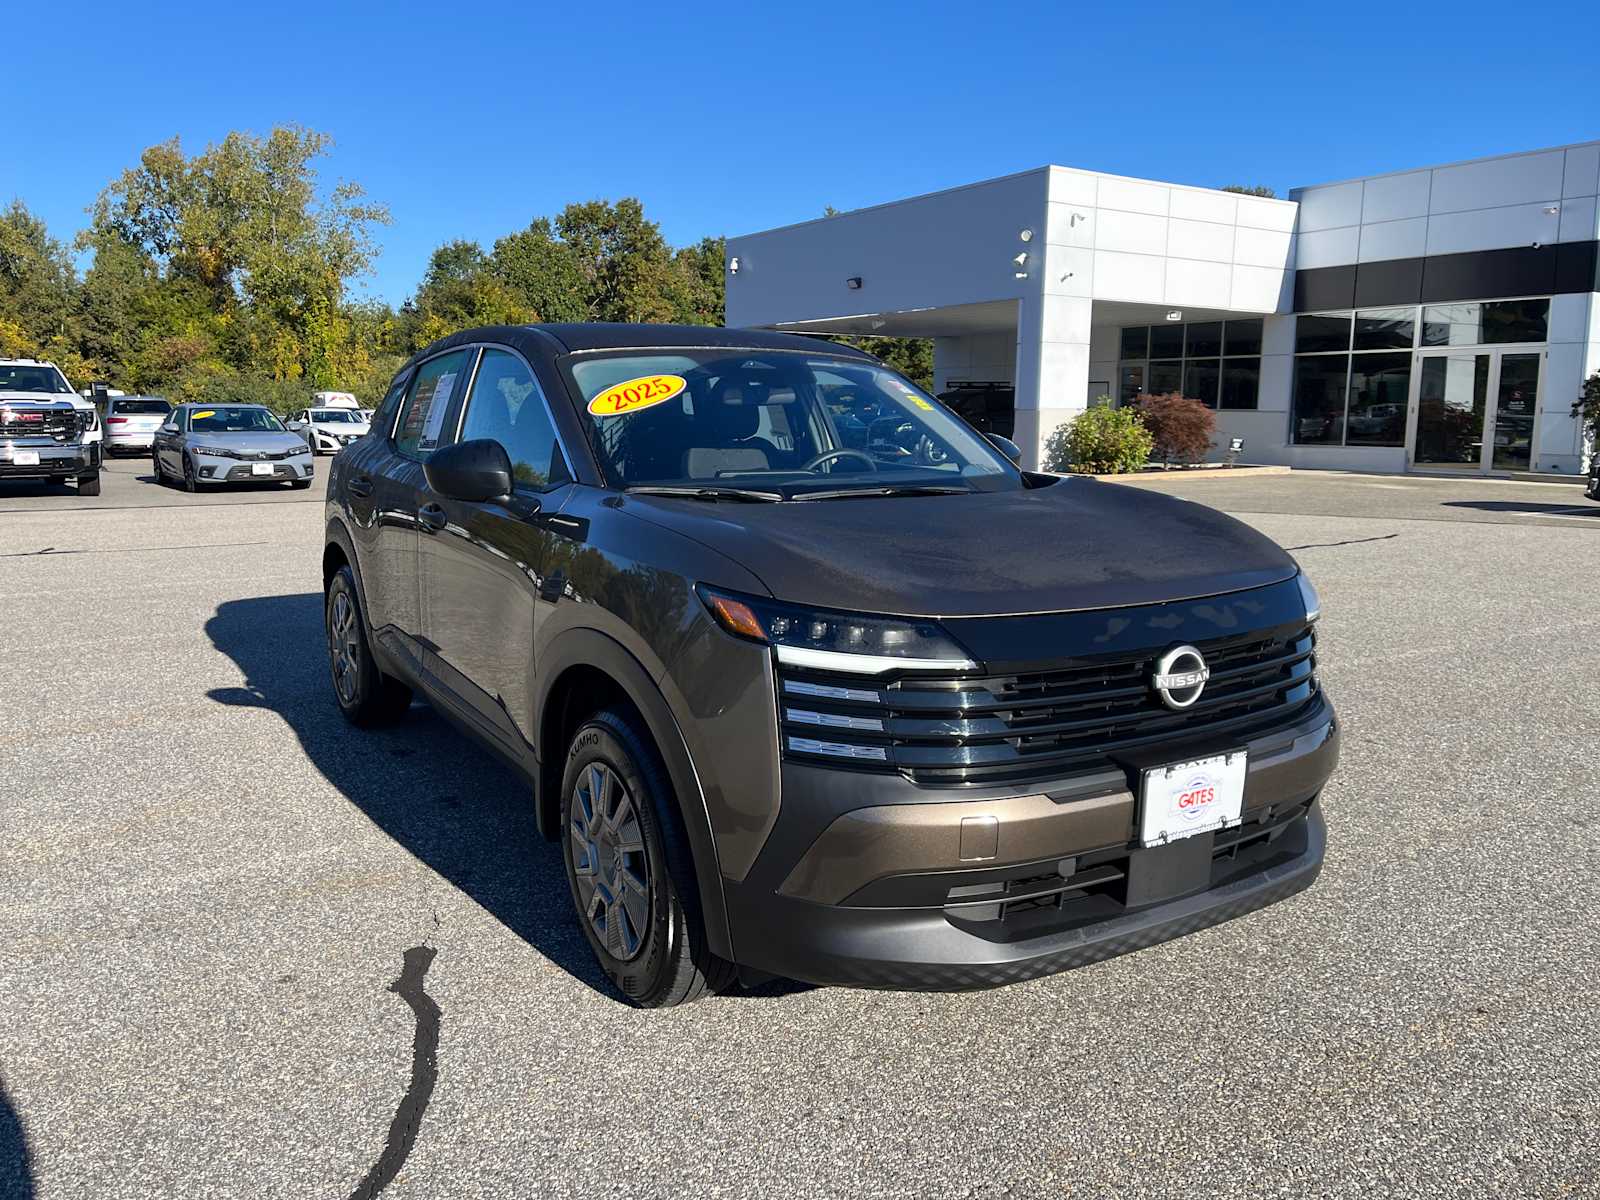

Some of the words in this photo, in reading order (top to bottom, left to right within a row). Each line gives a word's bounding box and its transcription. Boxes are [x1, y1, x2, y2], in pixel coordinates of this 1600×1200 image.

[607, 378, 672, 411] 2025
[1158, 666, 1210, 687] NISSAN
[570, 734, 598, 761] KUMHO
[1178, 787, 1214, 808] GATES
